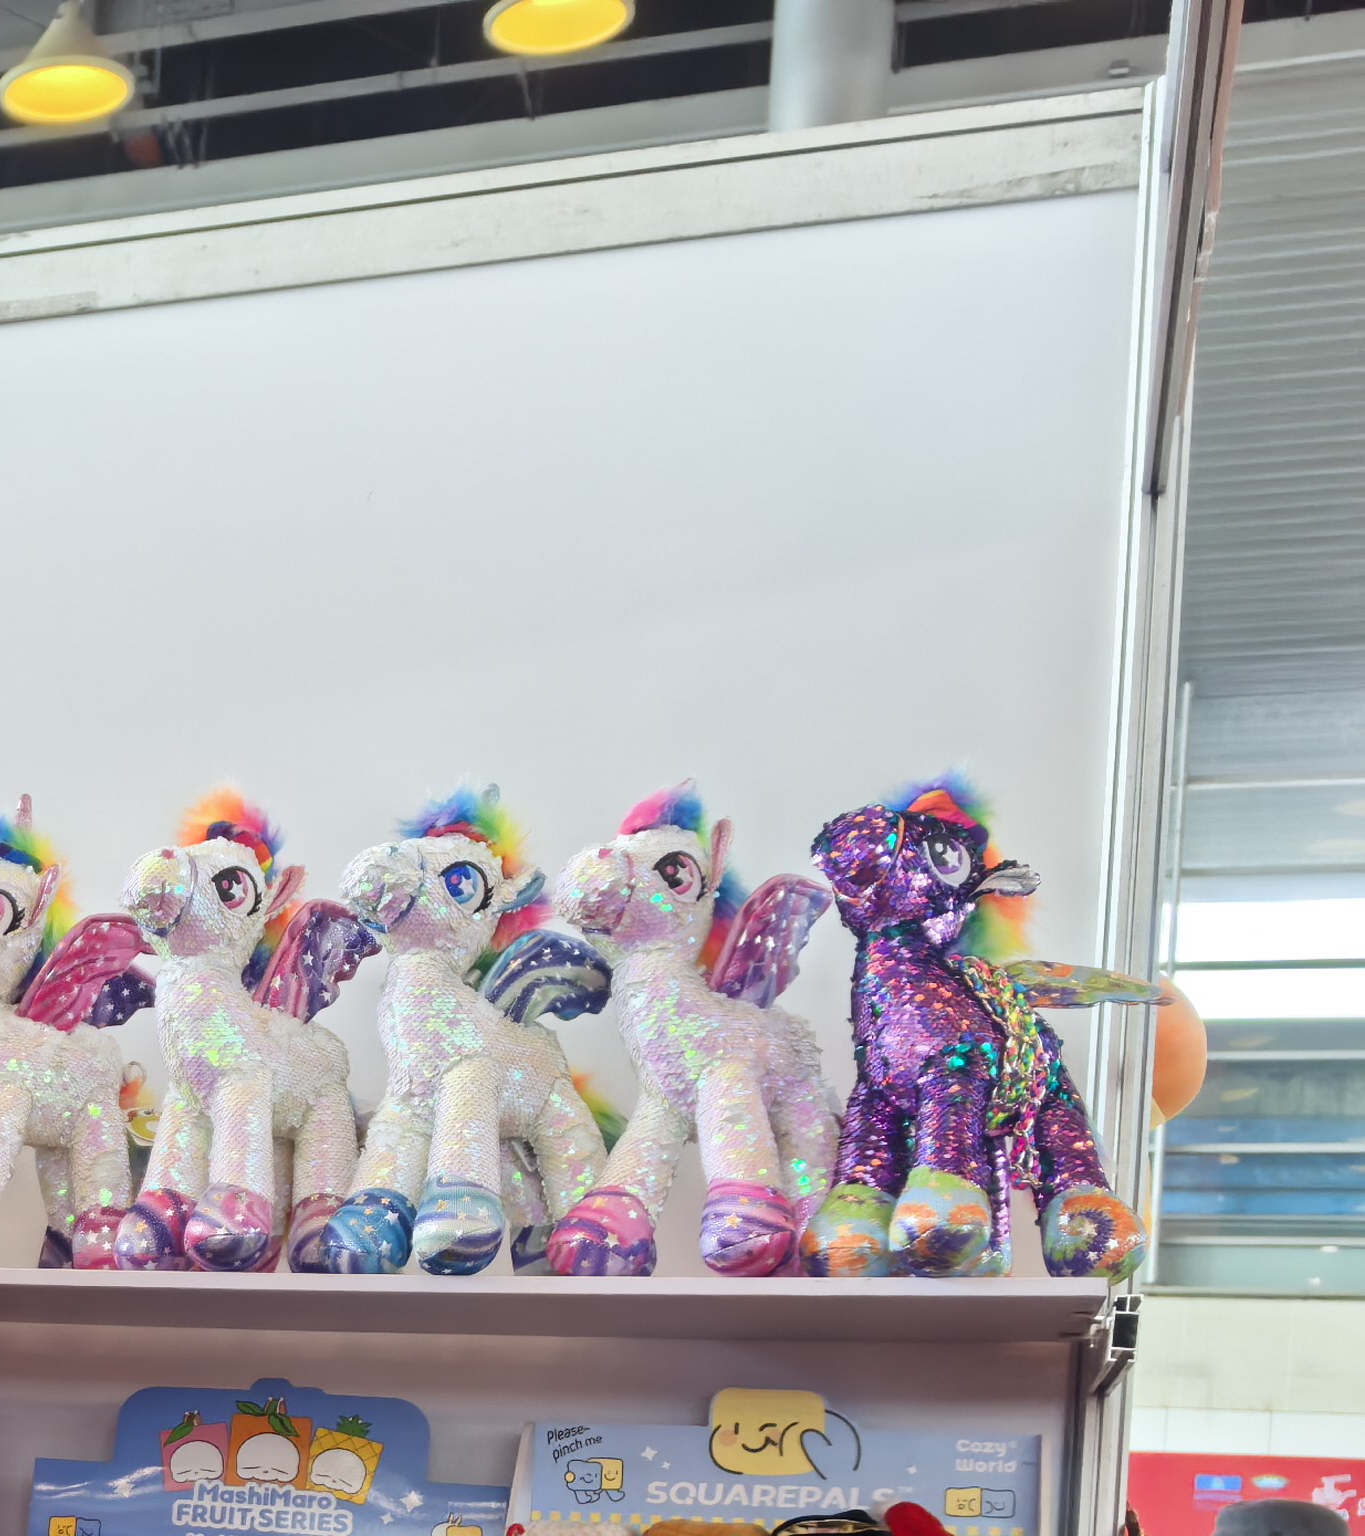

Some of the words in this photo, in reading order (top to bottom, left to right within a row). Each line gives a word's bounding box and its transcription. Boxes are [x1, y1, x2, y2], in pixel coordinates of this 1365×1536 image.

[552, 1438, 583, 1463] pinch
[585, 1435, 603, 1446] me
[955, 1458, 1018, 1474] World
[196, 1482, 333, 1510] MashiMaro
[176, 1503, 253, 1527] FRUIT
[257, 1509, 349, 1534] SERIES
